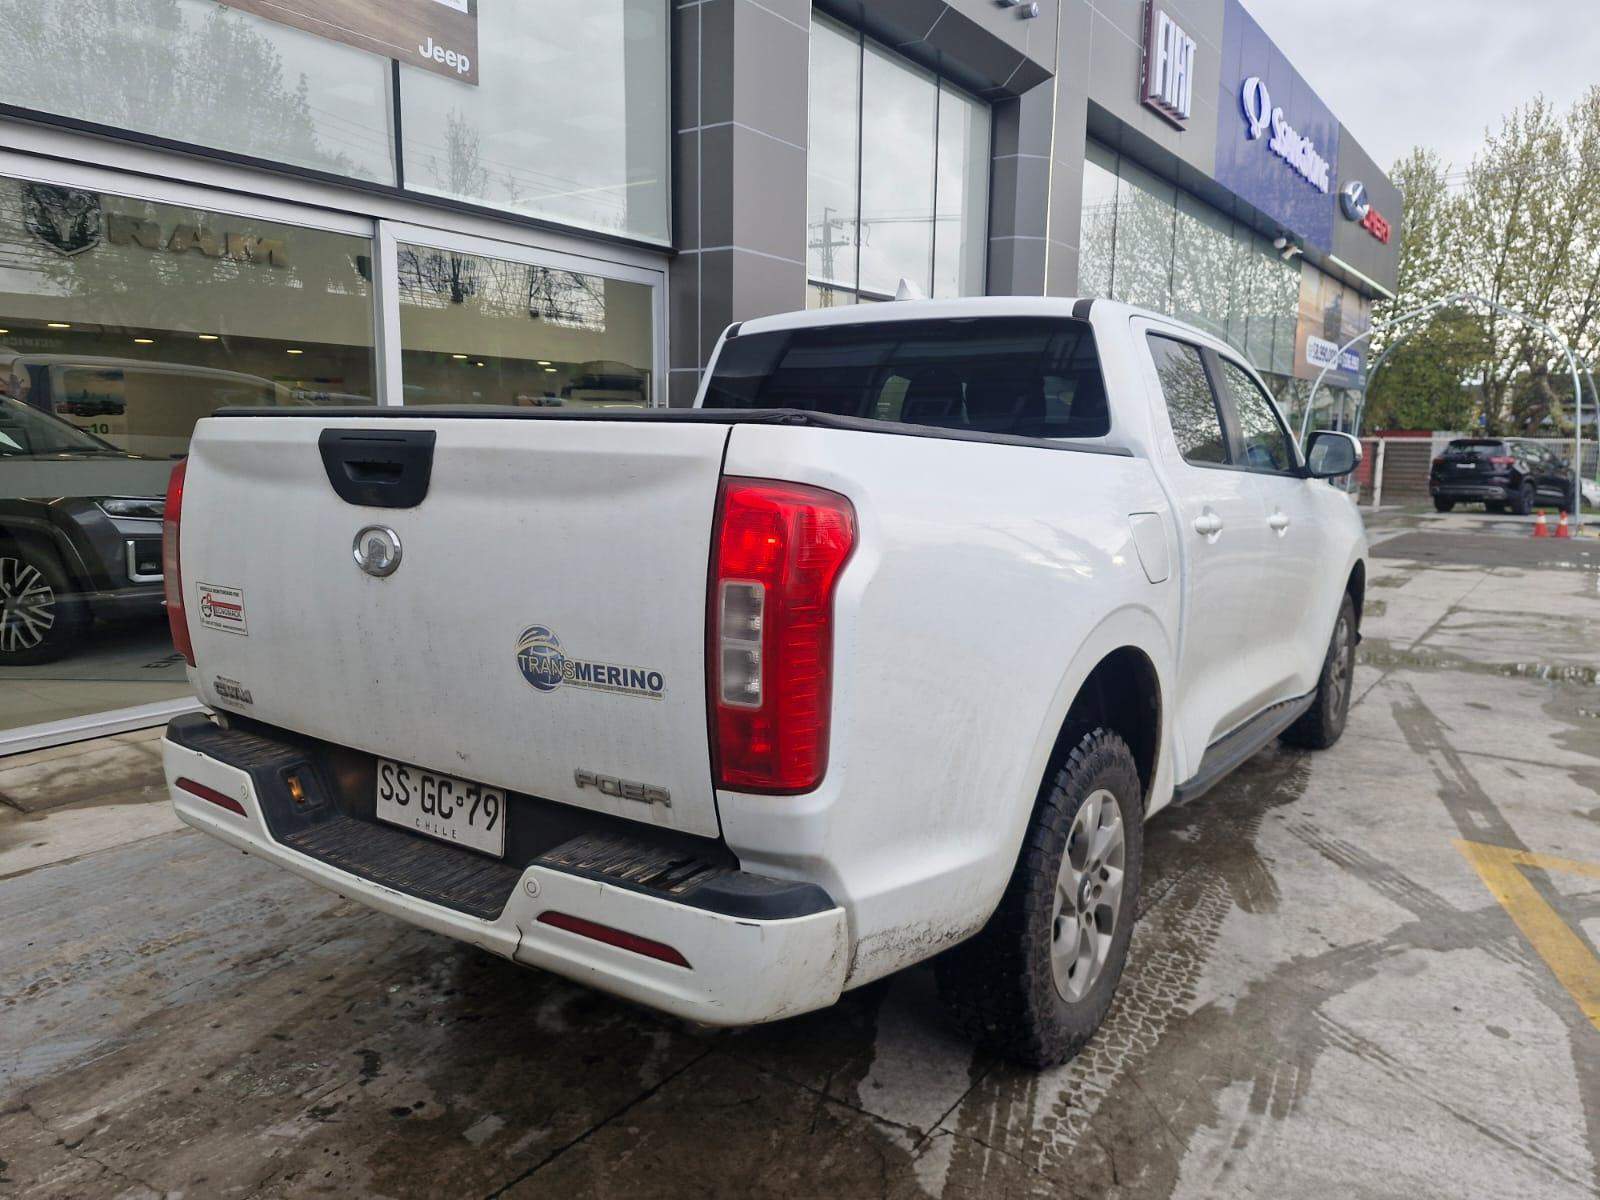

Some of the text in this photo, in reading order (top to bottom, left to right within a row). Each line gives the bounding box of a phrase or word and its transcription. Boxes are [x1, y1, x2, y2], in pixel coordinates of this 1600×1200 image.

[418, 36, 470, 74] Jeep
[1151, 9, 1197, 119] FIAT
[107, 212, 288, 267] RAM
[518, 653, 664, 692] TRANSMERINO
[574, 768, 672, 809] POER
[415, 818, 457, 839] CHILE
